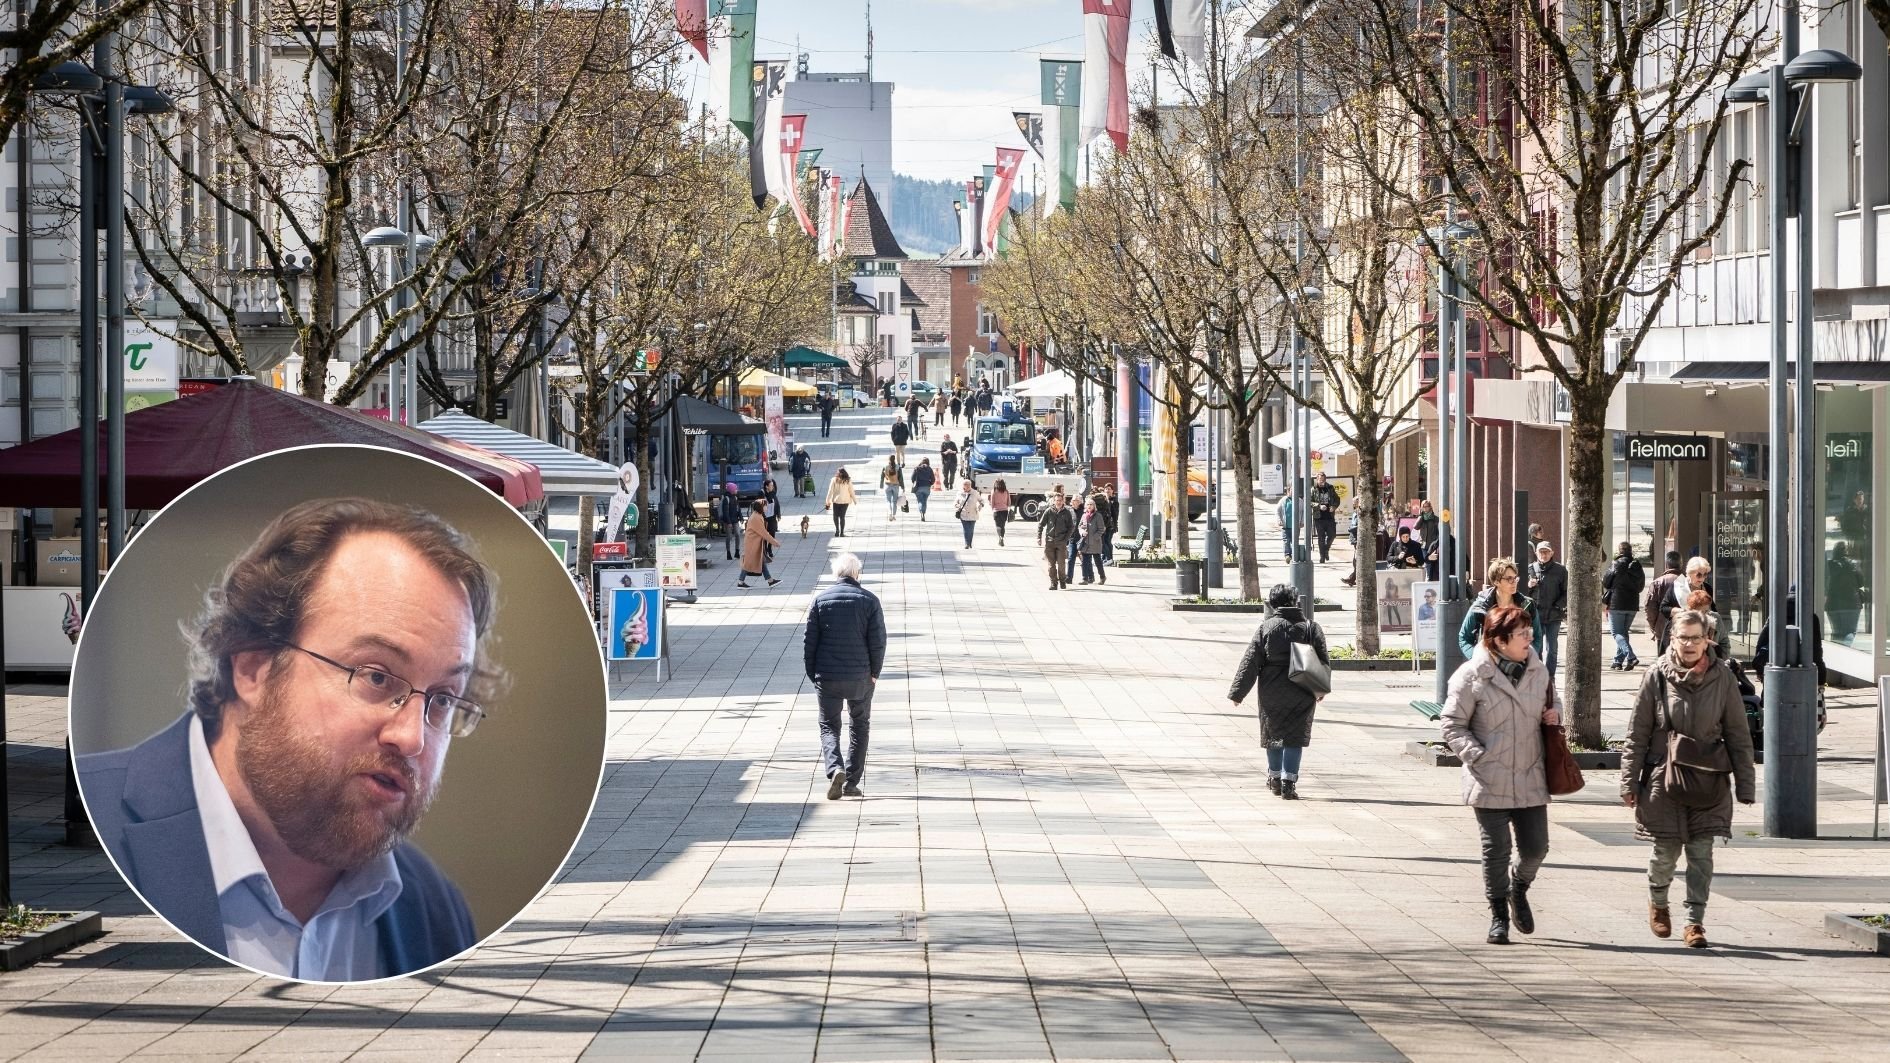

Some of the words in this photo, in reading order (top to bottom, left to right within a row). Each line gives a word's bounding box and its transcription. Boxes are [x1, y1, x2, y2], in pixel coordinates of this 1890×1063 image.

[682, 427, 708, 435] Tchibo
[1630, 439, 1706, 457] fielmann
[1717, 521, 1758, 533] fielmann
[1717, 546, 1758, 558] fielmann
